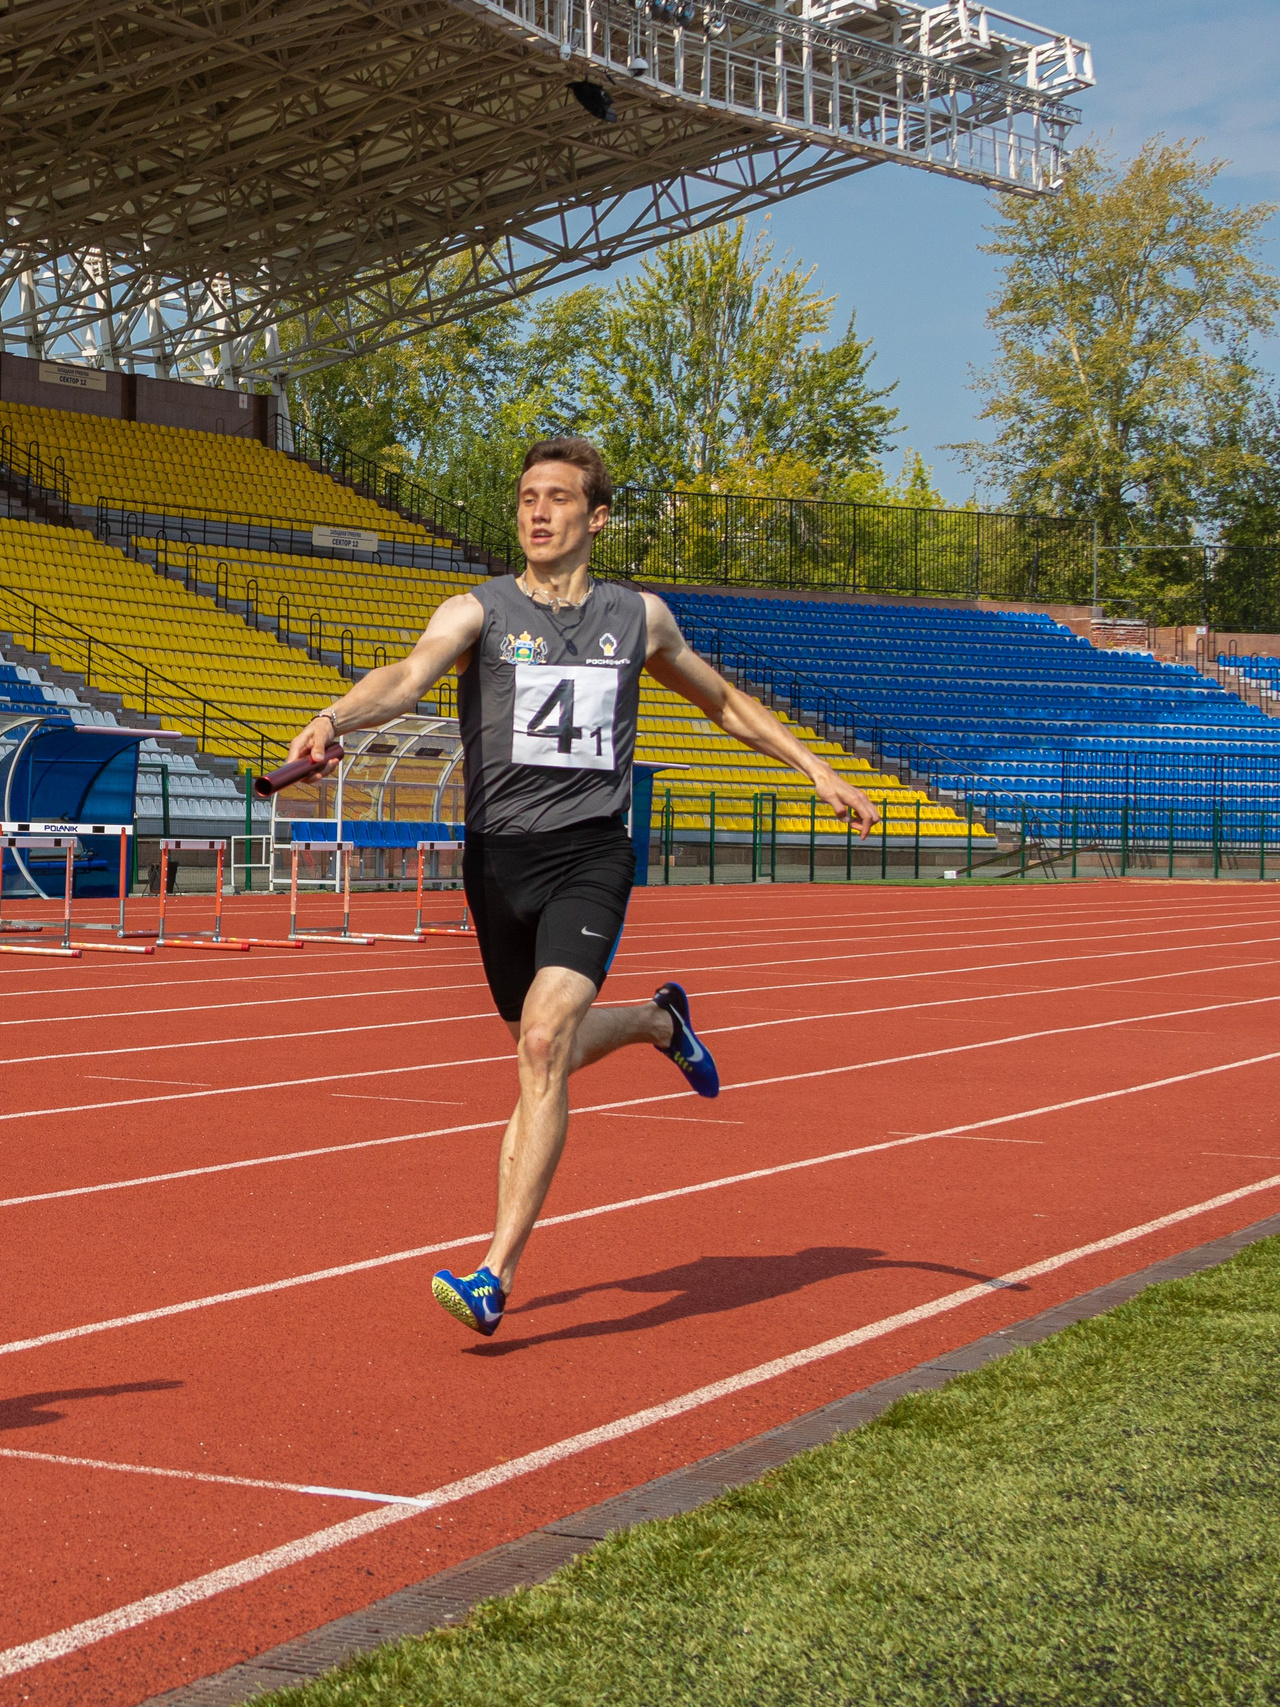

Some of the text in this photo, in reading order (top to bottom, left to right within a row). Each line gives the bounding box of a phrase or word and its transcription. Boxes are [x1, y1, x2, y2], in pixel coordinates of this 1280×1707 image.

[59, 376, 79, 384] СЕКТОР
[527, 679, 602, 756] 4 1
[44, 825, 78, 833] POLANIK
